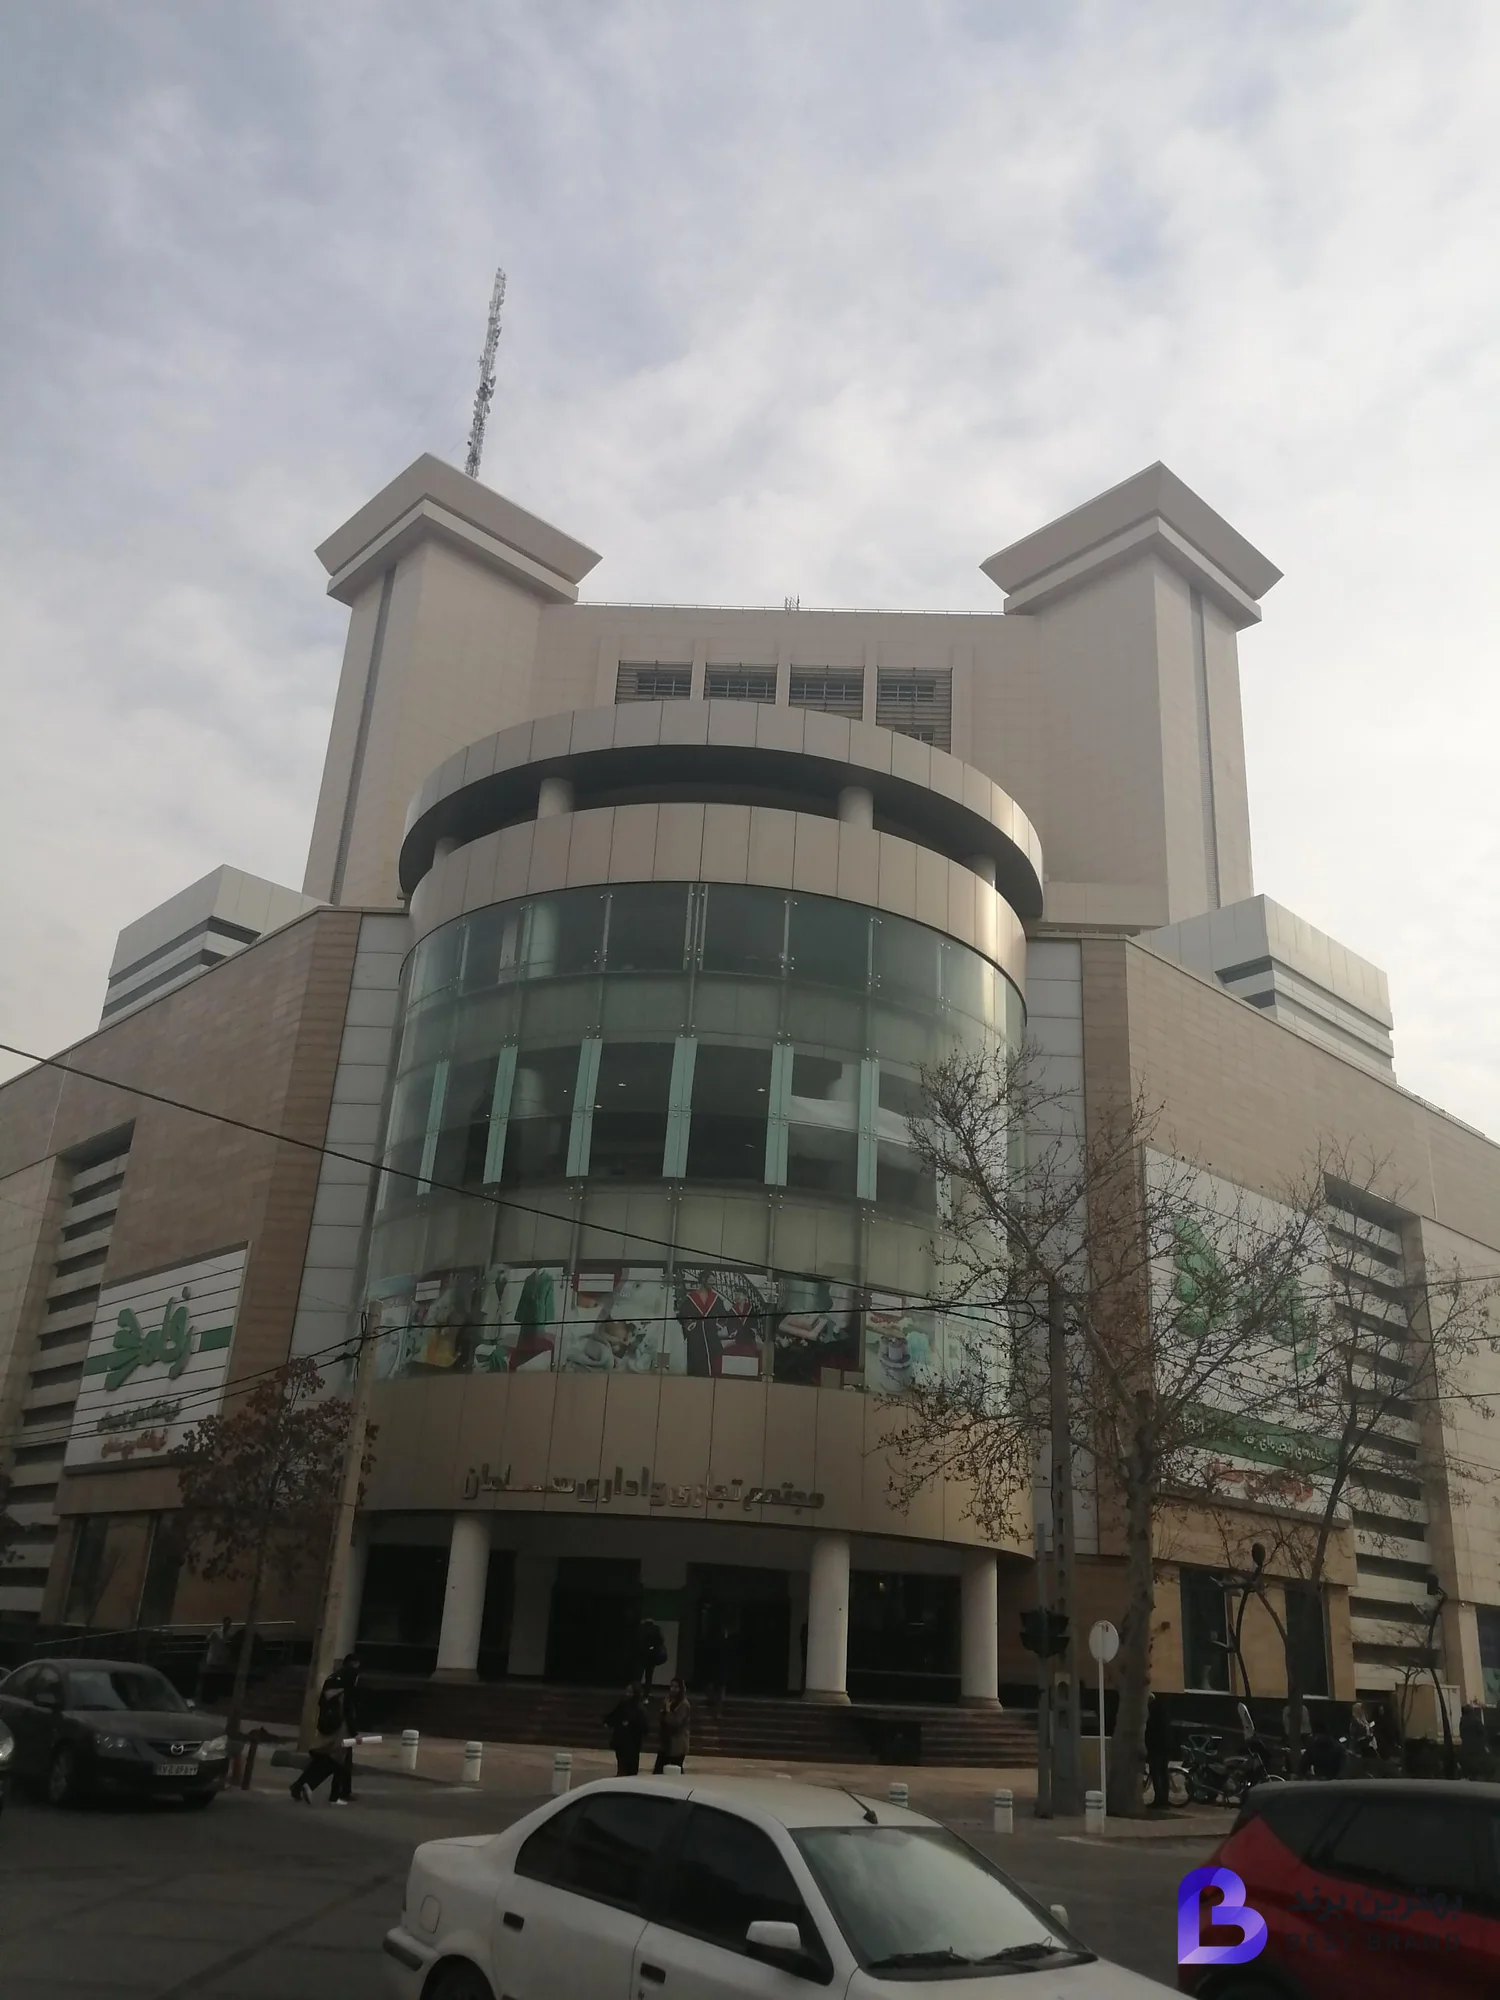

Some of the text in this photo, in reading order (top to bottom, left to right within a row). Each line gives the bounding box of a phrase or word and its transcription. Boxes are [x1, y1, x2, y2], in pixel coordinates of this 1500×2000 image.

[577, 1465, 651, 1503] اداری
[668, 1471, 744, 1510] تجاری
[743, 1481, 825, 1515] مجتمع
